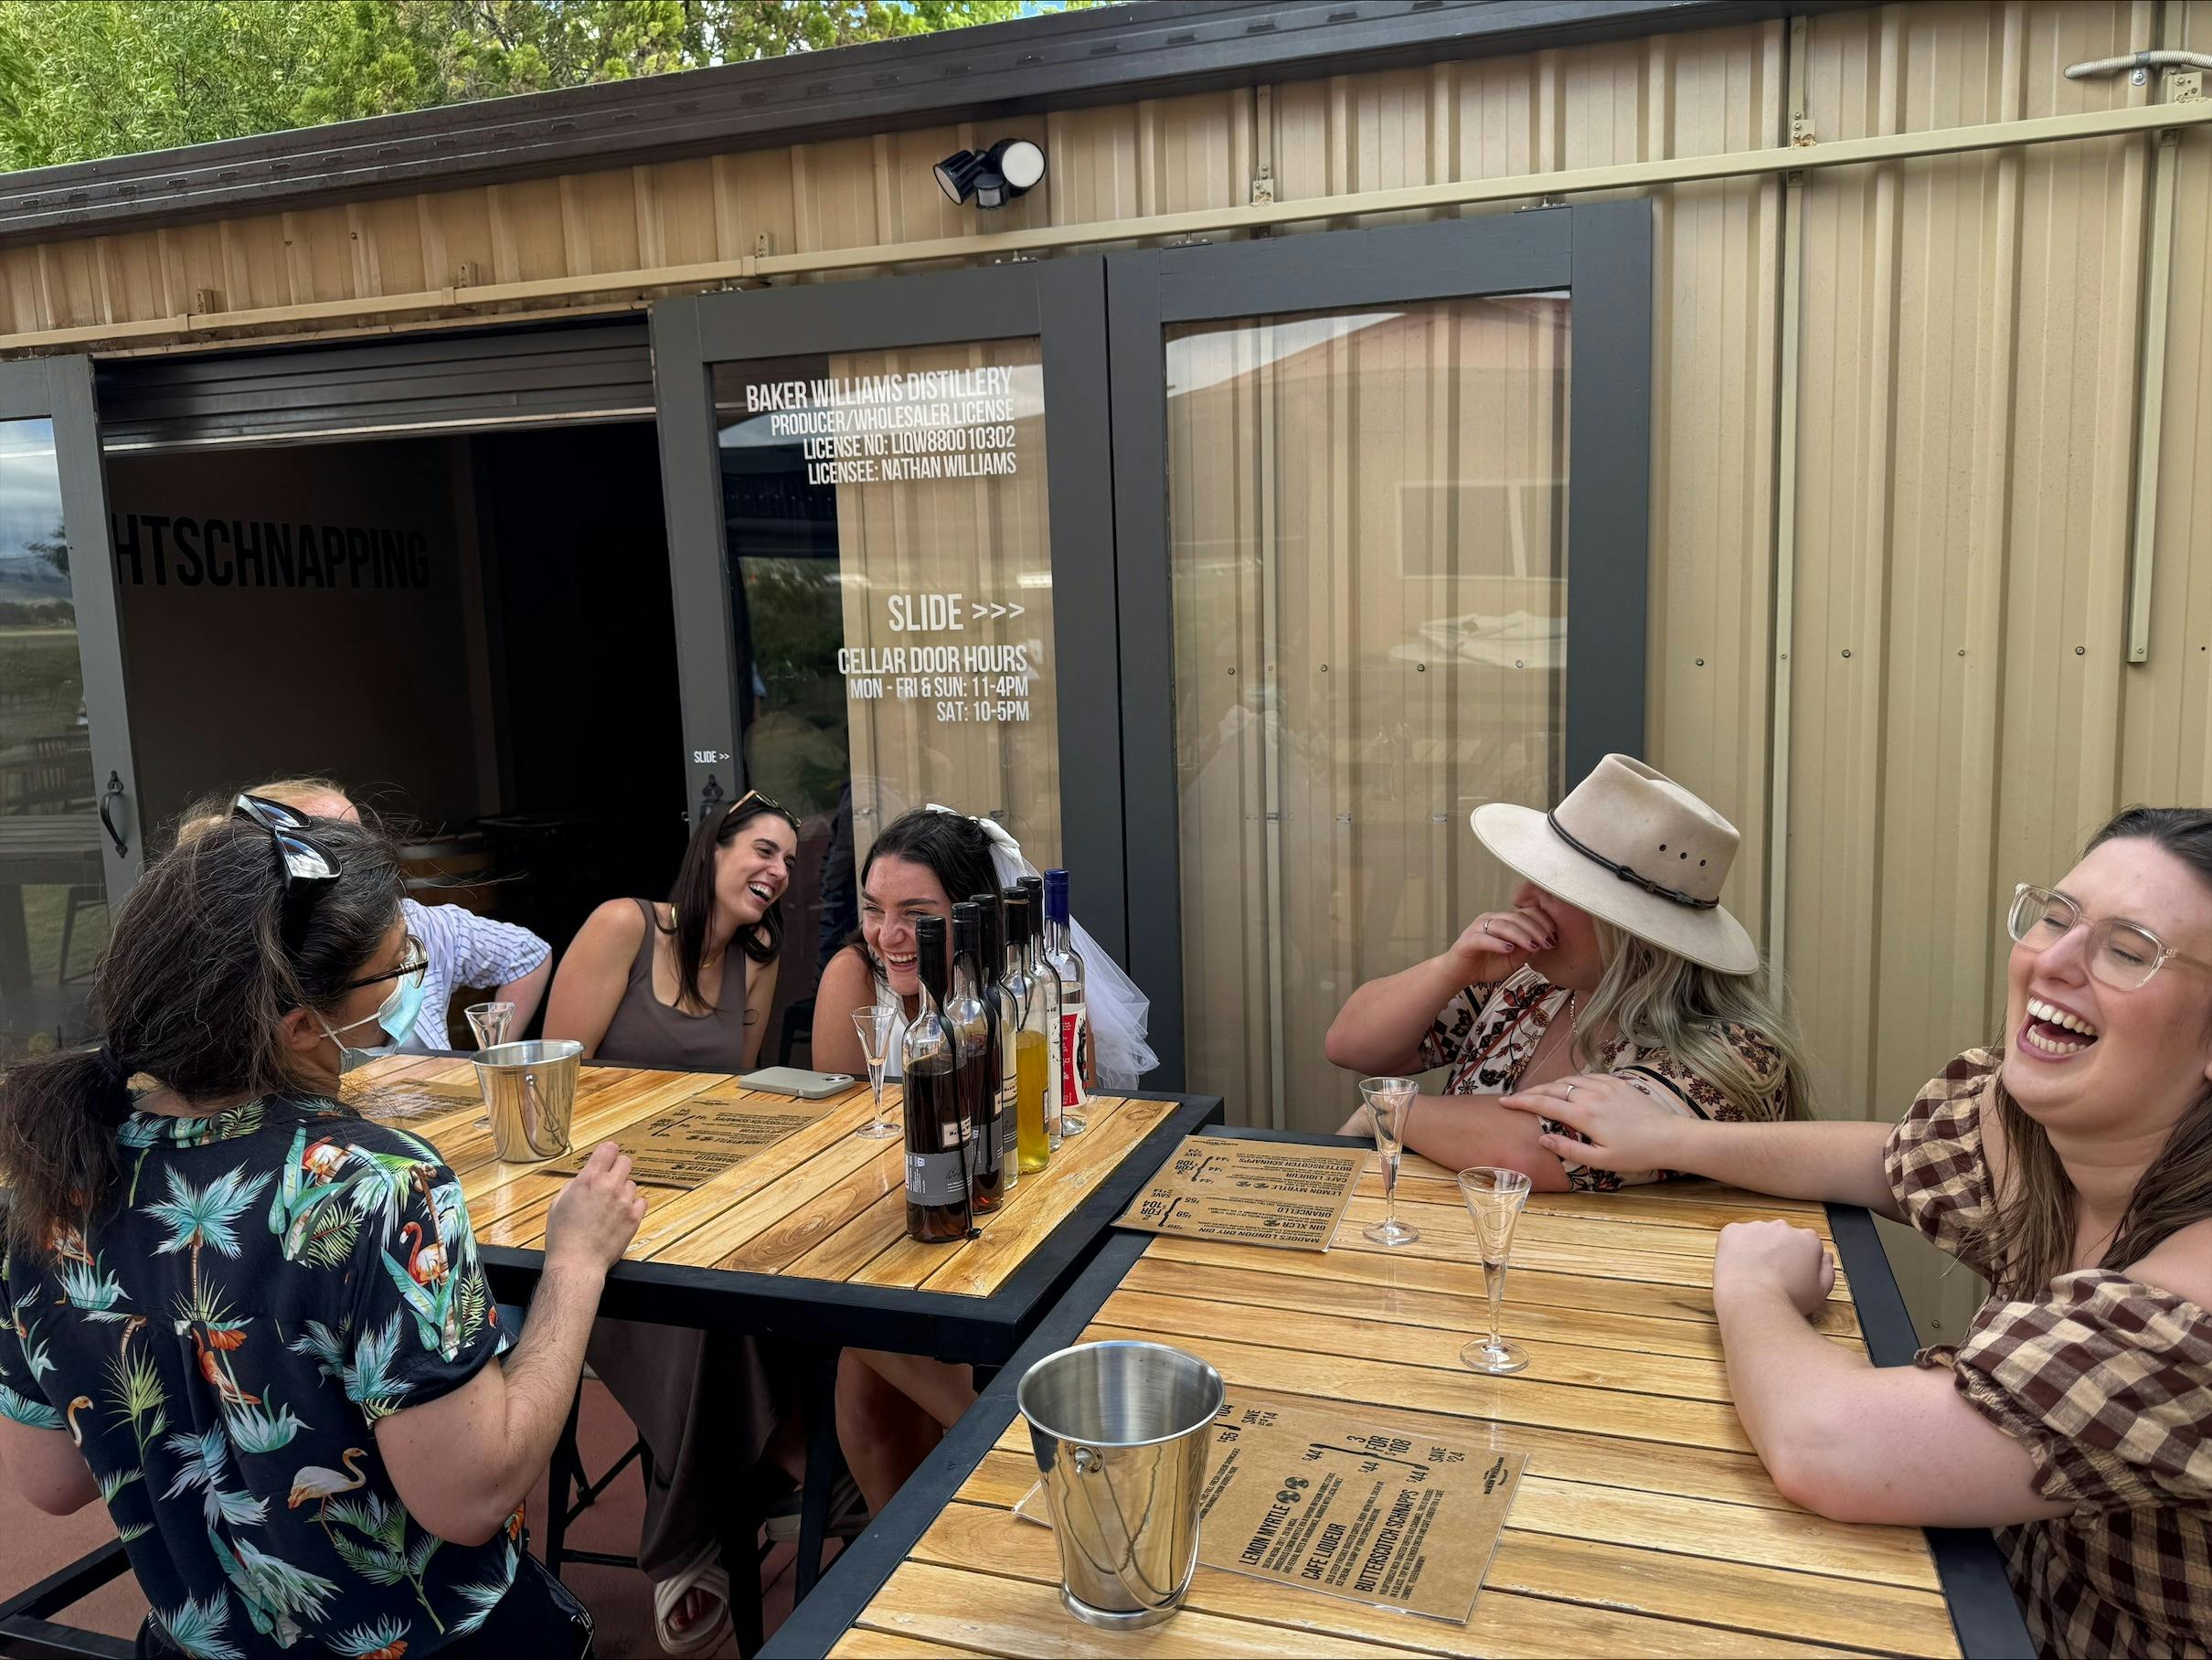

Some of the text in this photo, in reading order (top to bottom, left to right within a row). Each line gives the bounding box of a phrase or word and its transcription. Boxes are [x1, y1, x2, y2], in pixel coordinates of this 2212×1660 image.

[746, 366, 1013, 412] BAKER WILLIAMS DISTILLERY
[771, 399, 1015, 436] PRODUCER/WHOLESALER LICENSE
[803, 435, 860, 460] LICENSE
[864, 434, 888, 456] NO:
[807, 452, 1016, 485] LICENSEE: NATHAN WILLIAMS
[888, 593, 964, 631] SLIDE
[838, 644, 1027, 675] CELLAR DOOR HOURS
[850, 678, 883, 699] MON
[896, 677, 918, 698] FRI
[921, 677, 931, 697] &
[934, 676, 967, 697] SUN:
[972, 676, 1028, 697] 11-4PM
[937, 701, 1029, 722] SAT: 10-5PM
[694, 750, 717, 763] SLIDE
[1140, 1208, 1163, 1216] FOR
[1215, 1404, 1235, 1421] 104
[1241, 1409, 1261, 1424] SAVE
[1217, 1431, 1239, 1443] $55
[1365, 1436, 1389, 1452] FOR
[1302, 1449, 1323, 1461] $44
[1385, 1439, 1410, 1455] $108
[1429, 1447, 1446, 1463] SAVE
[1446, 1452, 1464, 1463] $24
[1358, 1462, 1378, 1473] $44
[1406, 1471, 1426, 1482] $44
[1239, 1505, 1290, 1565] LEMON MYRTLE
[1355, 1528, 1399, 1591] BUTTERSCOTCH
[1386, 1490, 1418, 1528] SCHNAPPS
[1302, 1524, 1345, 1580] CAFE LIQUEUR
